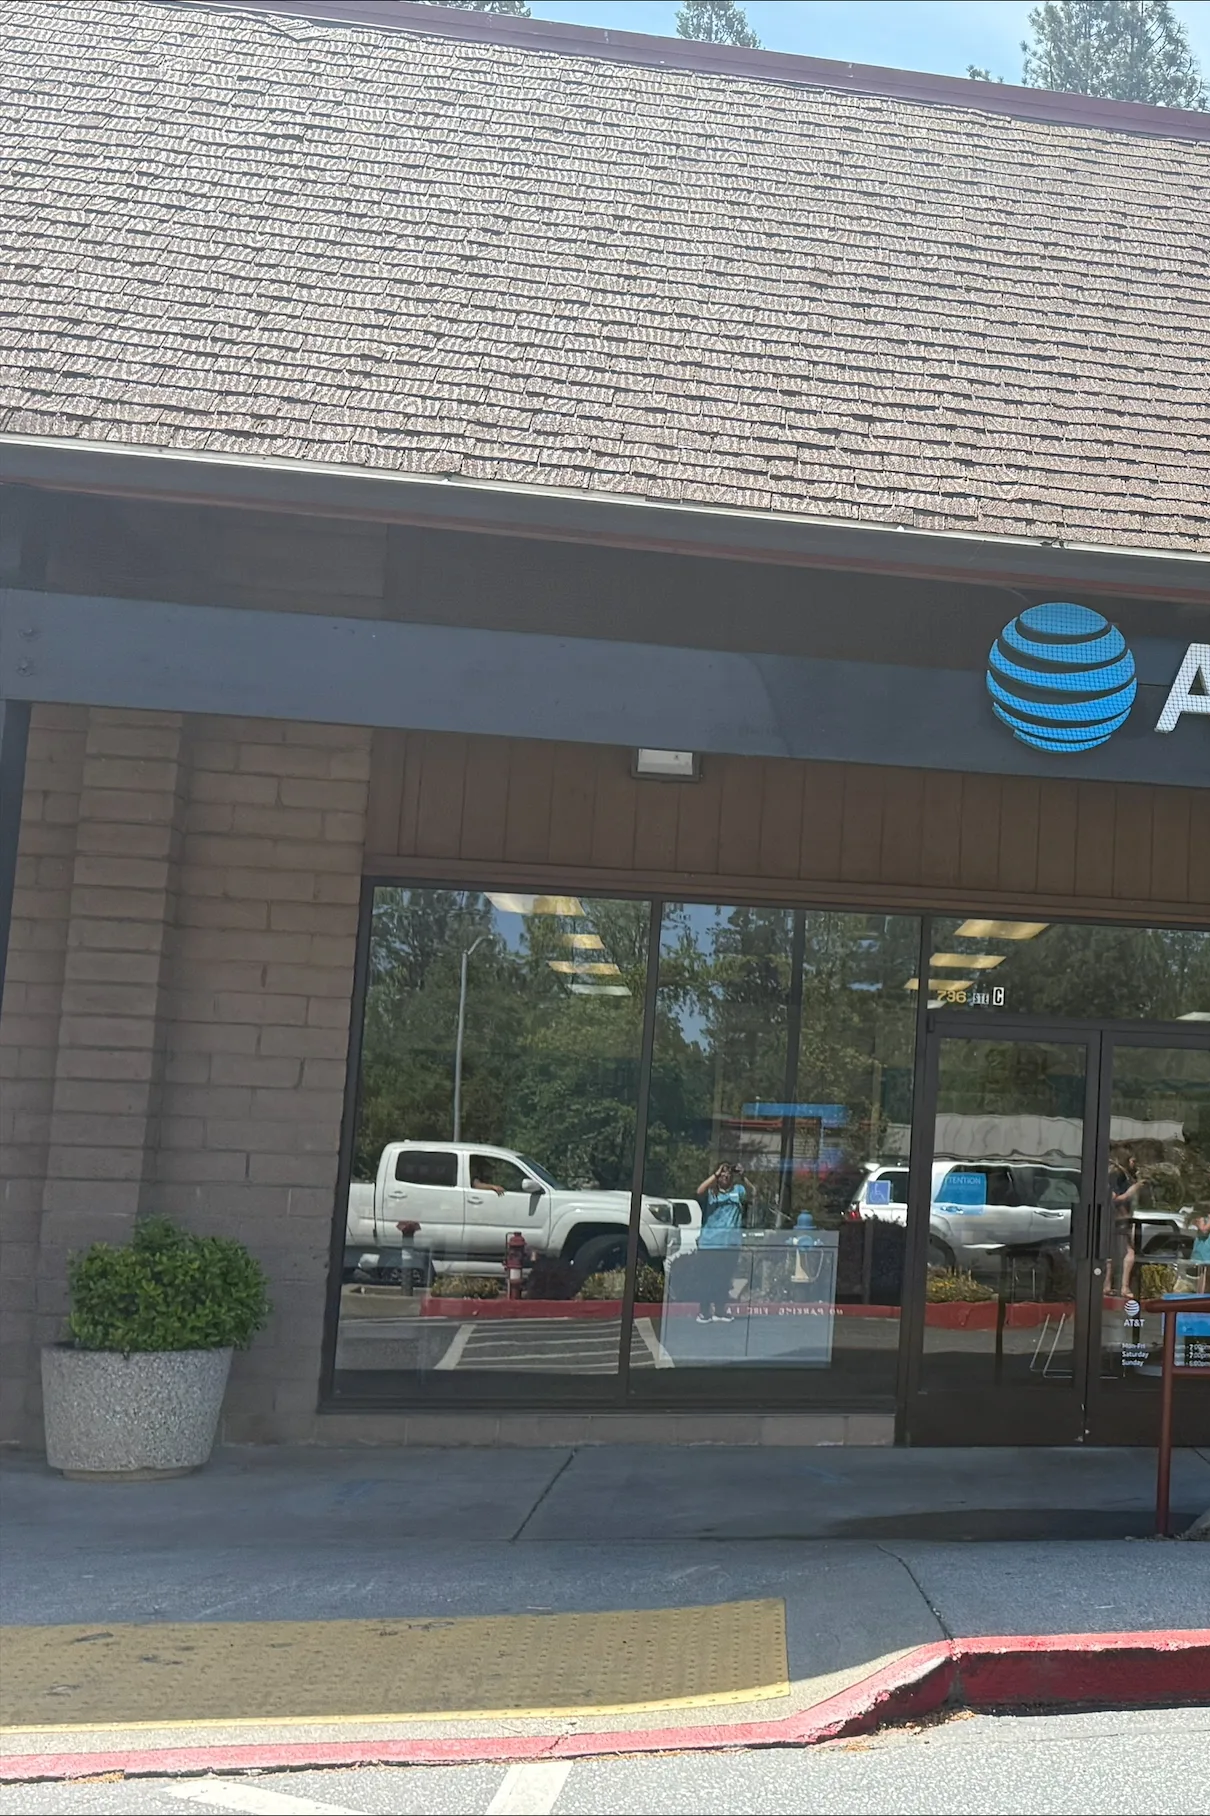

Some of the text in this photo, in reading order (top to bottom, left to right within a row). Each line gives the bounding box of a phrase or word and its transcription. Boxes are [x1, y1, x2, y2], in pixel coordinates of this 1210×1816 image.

[937, 988, 1003, 1005] 736 STE C
[1123, 1319, 1145, 1327] AT&T
[1122, 1359, 1144, 1367] Sunday
